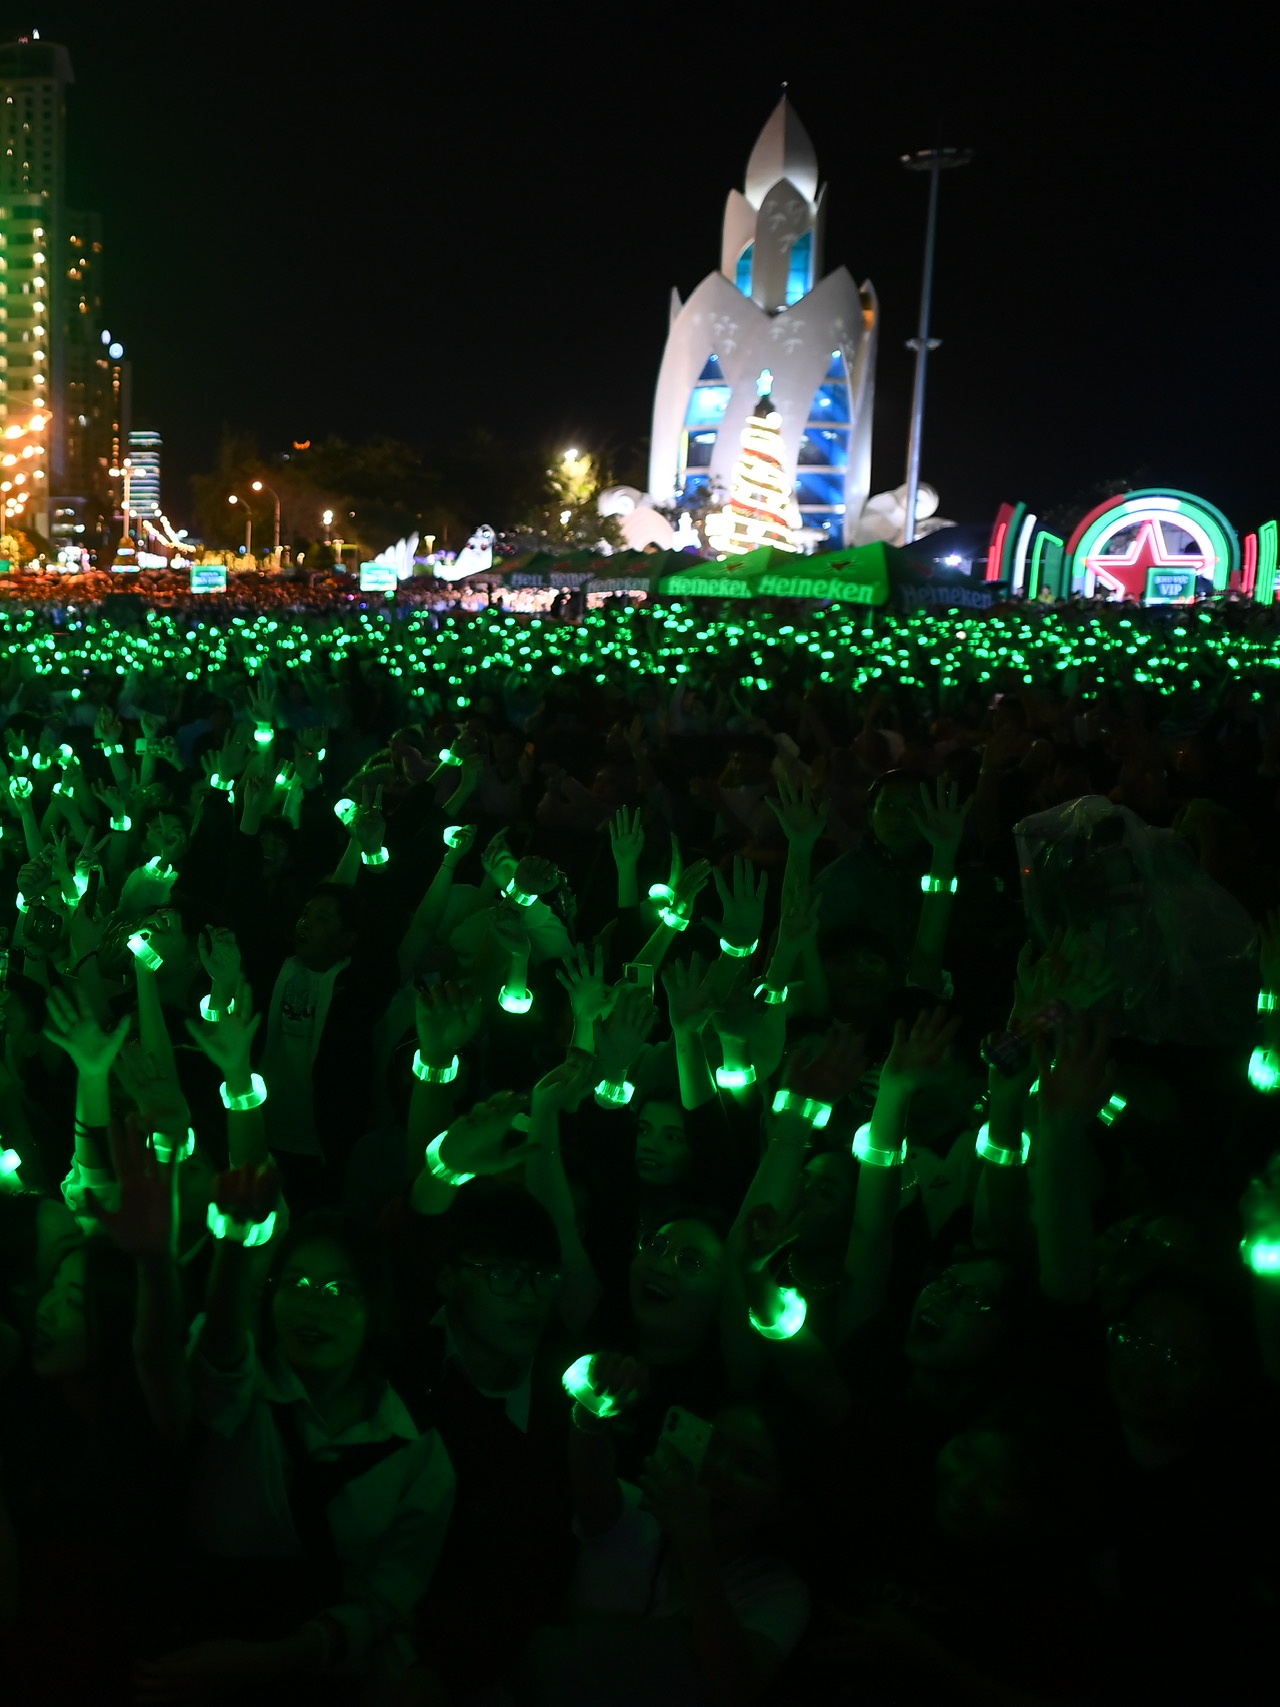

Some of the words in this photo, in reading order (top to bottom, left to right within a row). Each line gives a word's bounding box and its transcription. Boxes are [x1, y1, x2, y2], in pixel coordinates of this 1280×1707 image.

[758, 575, 875, 603] Heineken
[900, 583, 993, 610] Heineken
[1160, 584, 1183, 596] VIP
